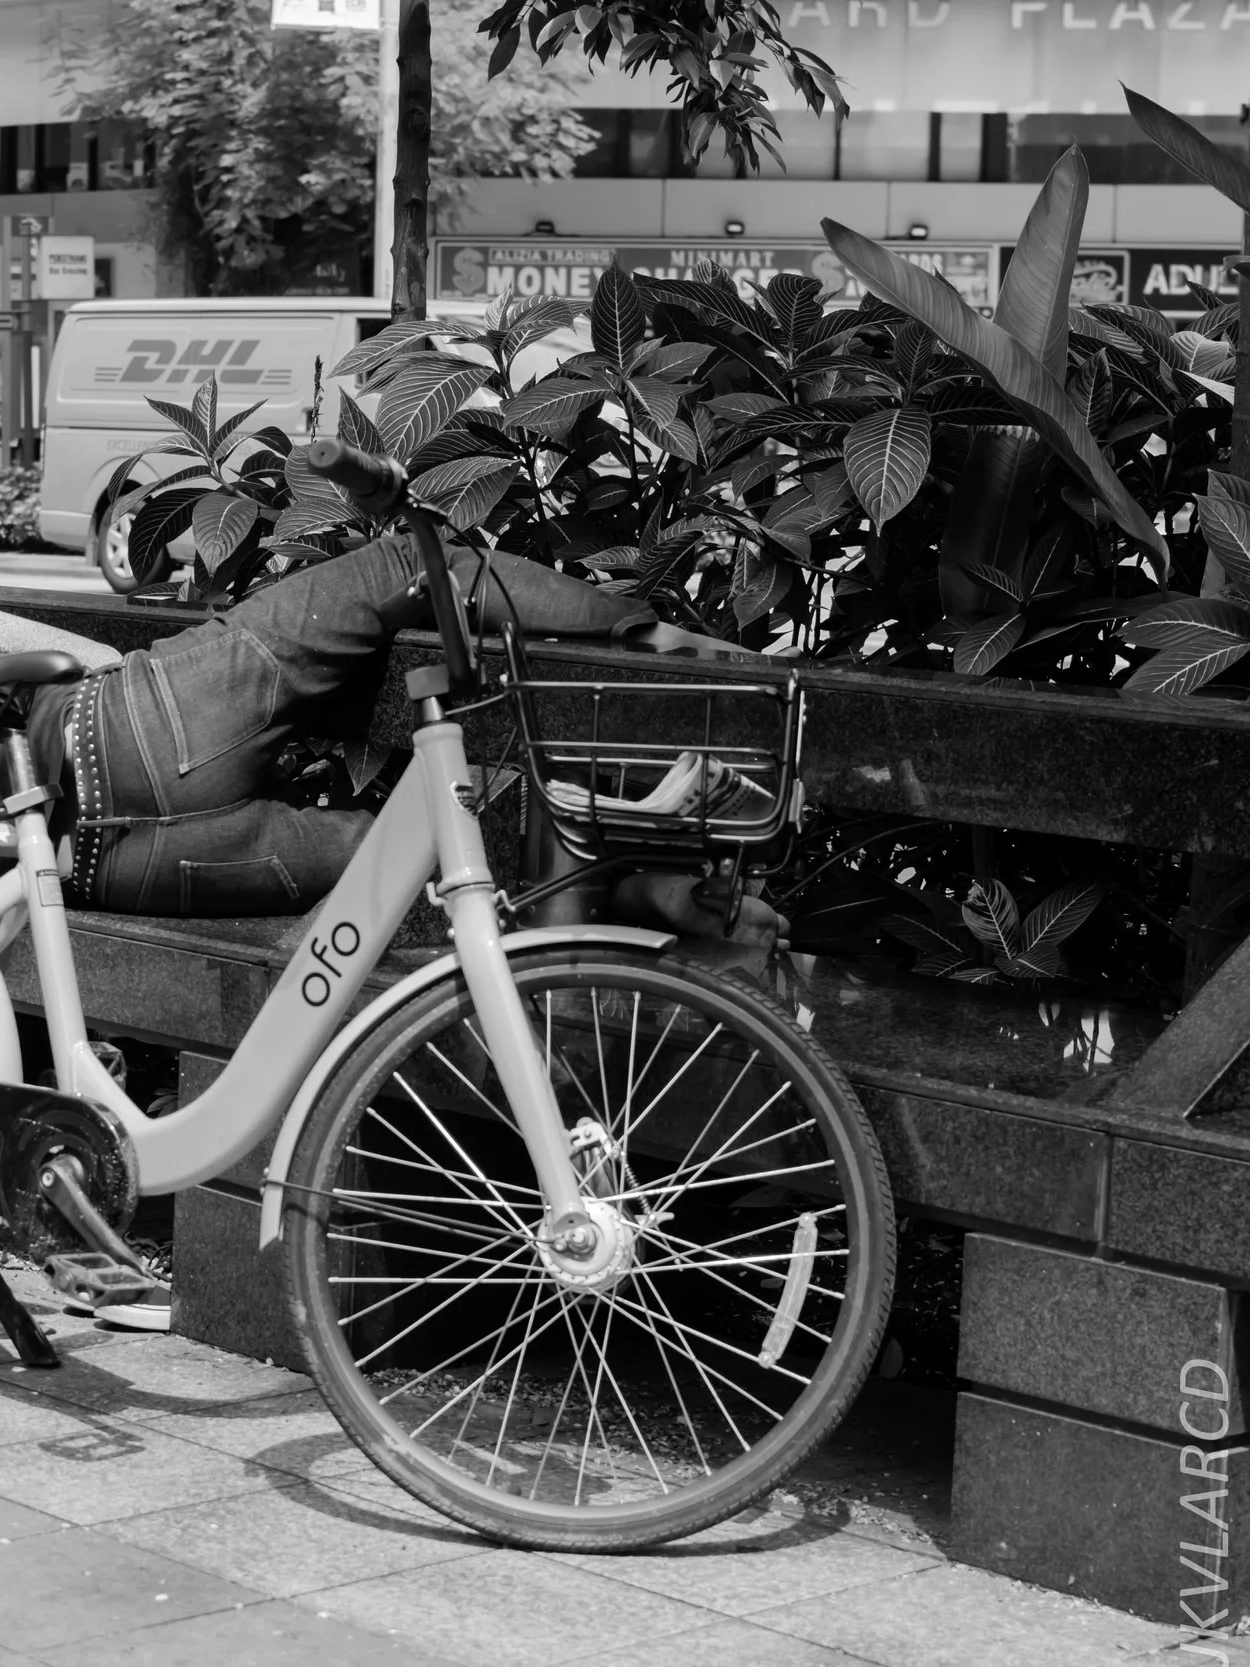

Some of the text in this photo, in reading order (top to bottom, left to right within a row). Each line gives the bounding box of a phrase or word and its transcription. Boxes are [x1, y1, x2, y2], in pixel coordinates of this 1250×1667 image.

[486, 265, 604, 297] MONE
[1142, 263, 1240, 295] ADUL
[117, 339, 262, 385] DHL
[302, 921, 361, 1007] ofo
